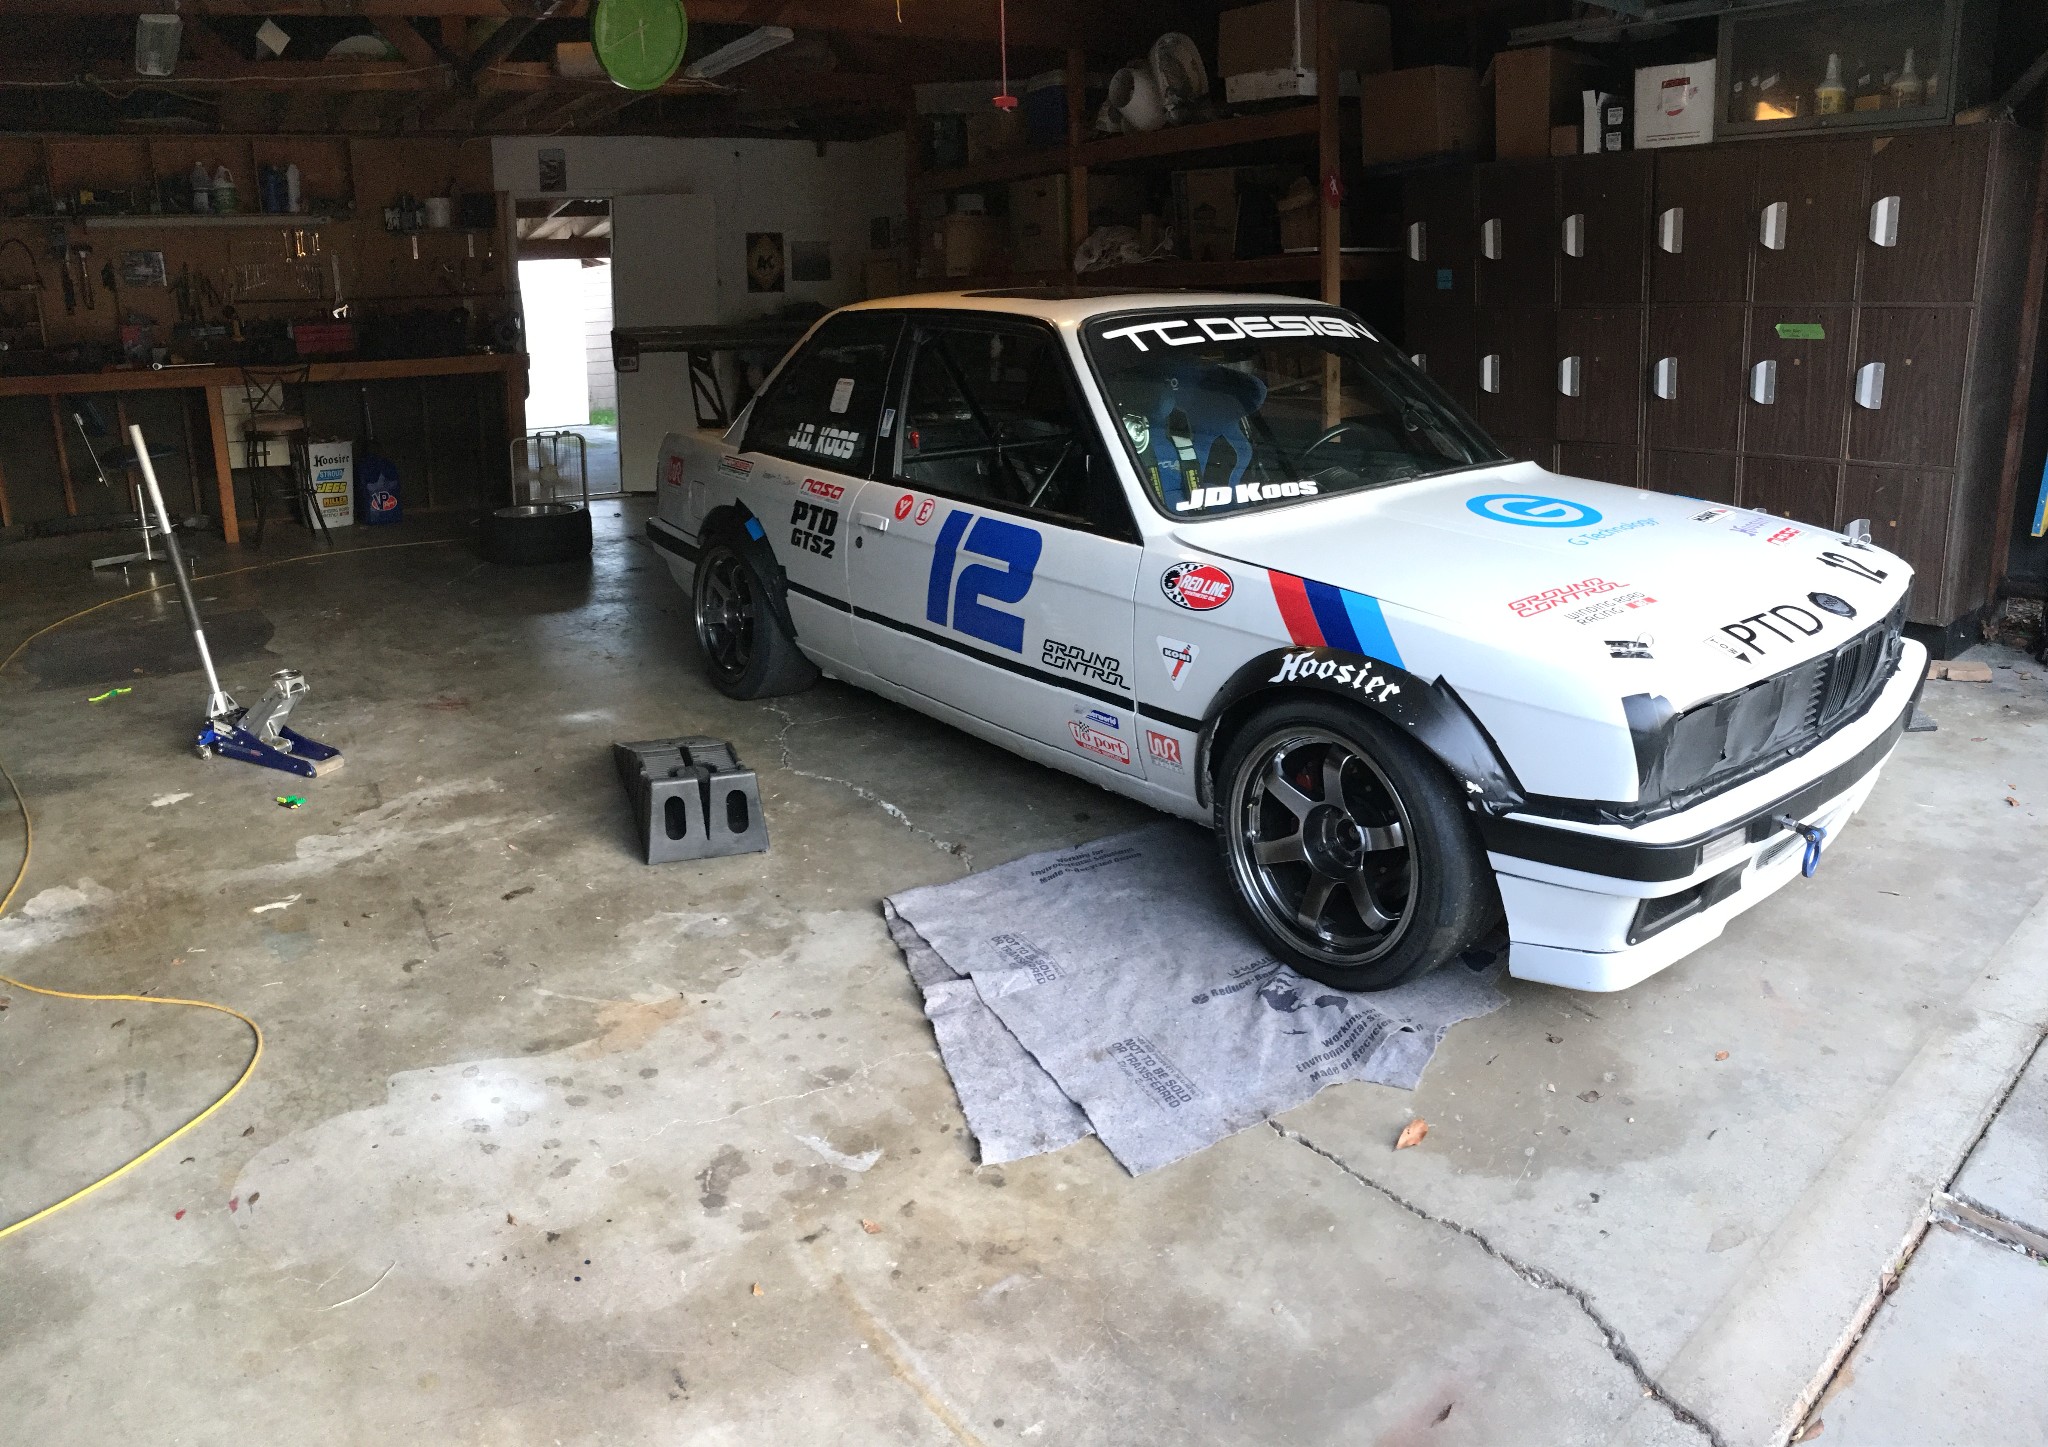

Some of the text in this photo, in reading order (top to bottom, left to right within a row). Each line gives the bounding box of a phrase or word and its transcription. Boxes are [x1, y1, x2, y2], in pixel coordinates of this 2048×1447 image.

[814, 427, 859, 459] KOOS
[313, 454, 349, 467] Hoosier
[320, 482, 347, 493] JEGS
[801, 478, 845, 500] nasa
[1176, 486, 1232, 511] JD
[791, 500, 839, 537] PTD
[791, 528, 836, 559] GTS2
[927, 510, 1043, 654] 12
[1816, 552, 1888, 584] 12
[1180, 575, 1231, 599] RED LINE
[1507, 577, 1604, 611] GROUND
[1517, 582, 1631, 618] CONTROL
[1720, 604, 1823, 656] PTD
[1042, 651, 1131, 690] CONTROL
[1043, 638, 1120, 672] GROUND
[1163, 648, 1192, 663] KONI
[1268, 651, 1401, 703] Hoosier
[1094, 736, 1126, 756] port
[1039, 870, 1063, 884] Made
[1035, 960, 1056, 981] SOLD
[1295, 1020, 1368, 1073] Environmental
[1321, 1013, 1362, 1048] Working
[1112, 1042, 1128, 1053] OR
[1124, 1053, 1181, 1108] TRANSFERRED
[1123, 1038, 1146, 1055] NOT
[1141, 1055, 1156, 1067] TO
[1153, 1067, 1169, 1080] BE
[1165, 1079, 1192, 1103] SOLD
[1309, 1066, 1340, 1082] Made
[1340, 1058, 1353, 1070] of
